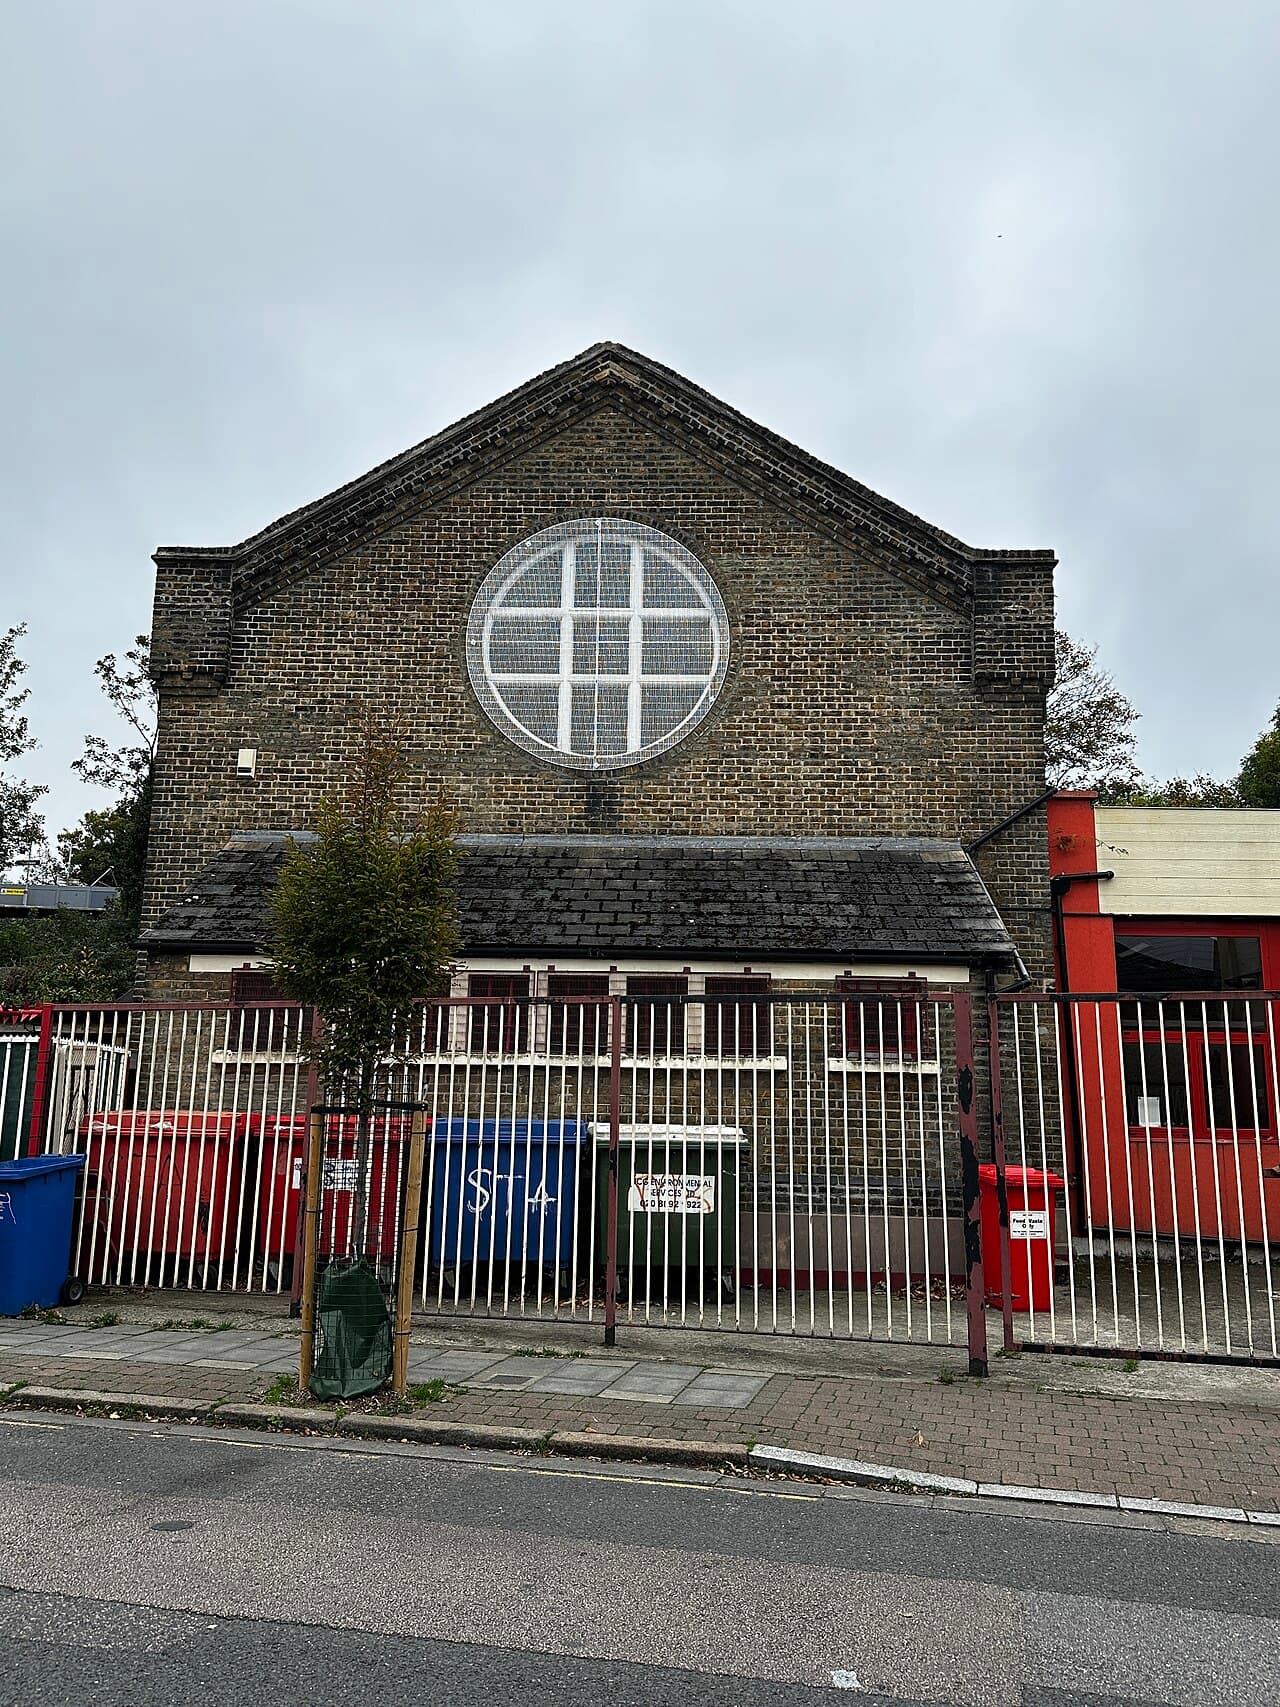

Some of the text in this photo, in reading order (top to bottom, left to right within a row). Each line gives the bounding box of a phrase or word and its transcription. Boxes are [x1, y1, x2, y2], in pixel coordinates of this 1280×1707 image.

[650, 1178, 713, 1187] ENRONMENAL
[649, 1188, 682, 1197] ERVCES
[681, 1200, 702, 1209] 922
